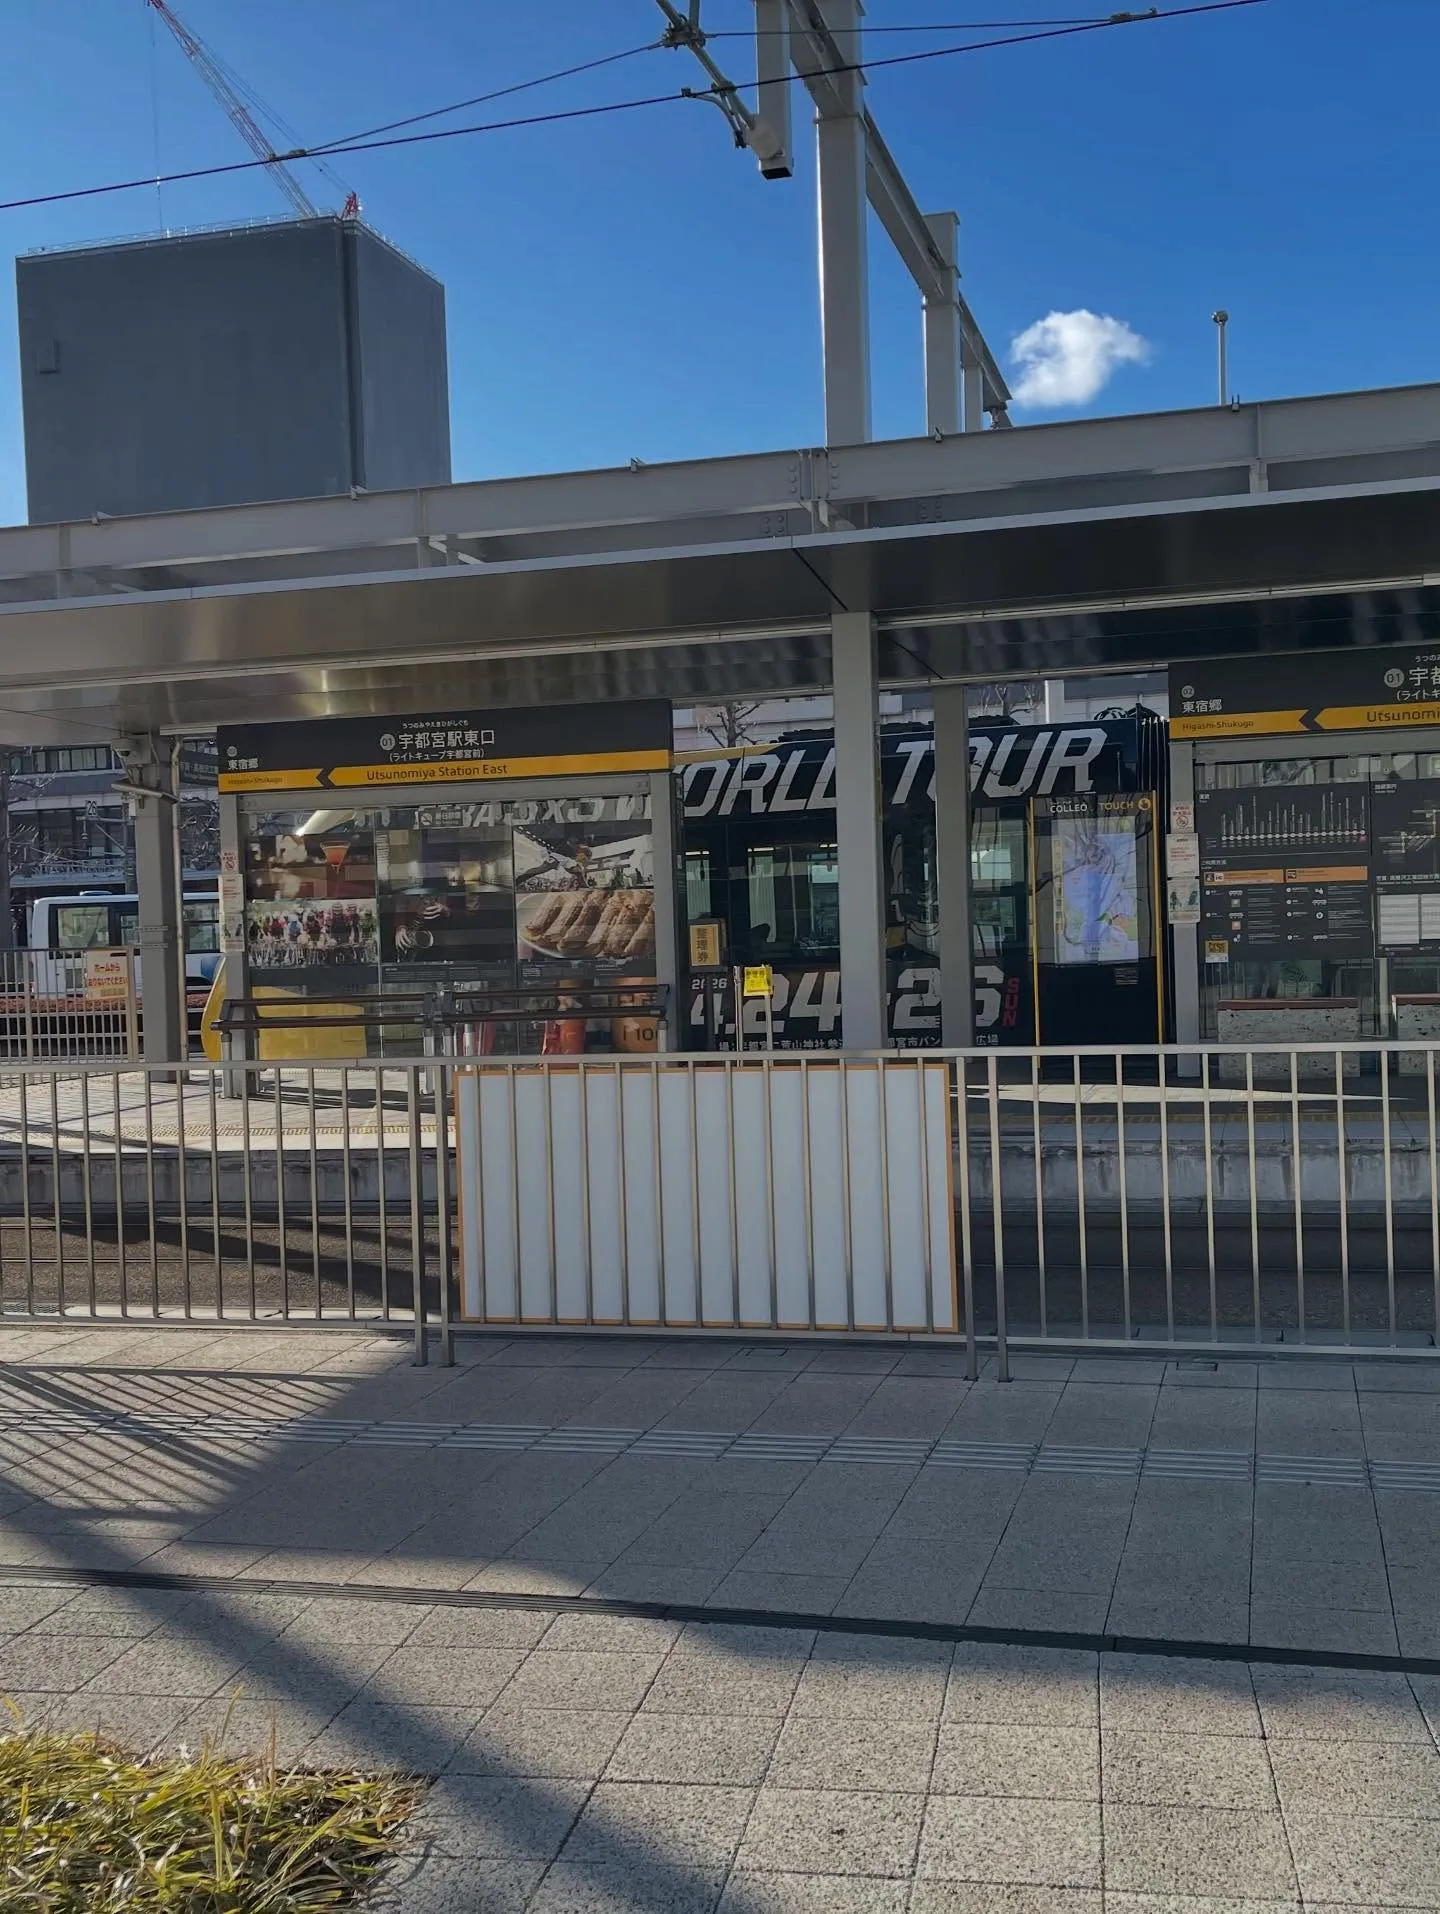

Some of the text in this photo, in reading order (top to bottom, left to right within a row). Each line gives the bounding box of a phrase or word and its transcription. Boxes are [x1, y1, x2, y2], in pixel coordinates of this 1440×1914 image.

[1182, 699, 1222, 713] 東宿郷
[398, 729, 495, 749] 宇都宮駅東口
[367, 764, 508, 781] Utsunomiya Station East
[1100, 801, 1134, 811] TOUCH
[1003, 977, 1020, 1027] SUN
